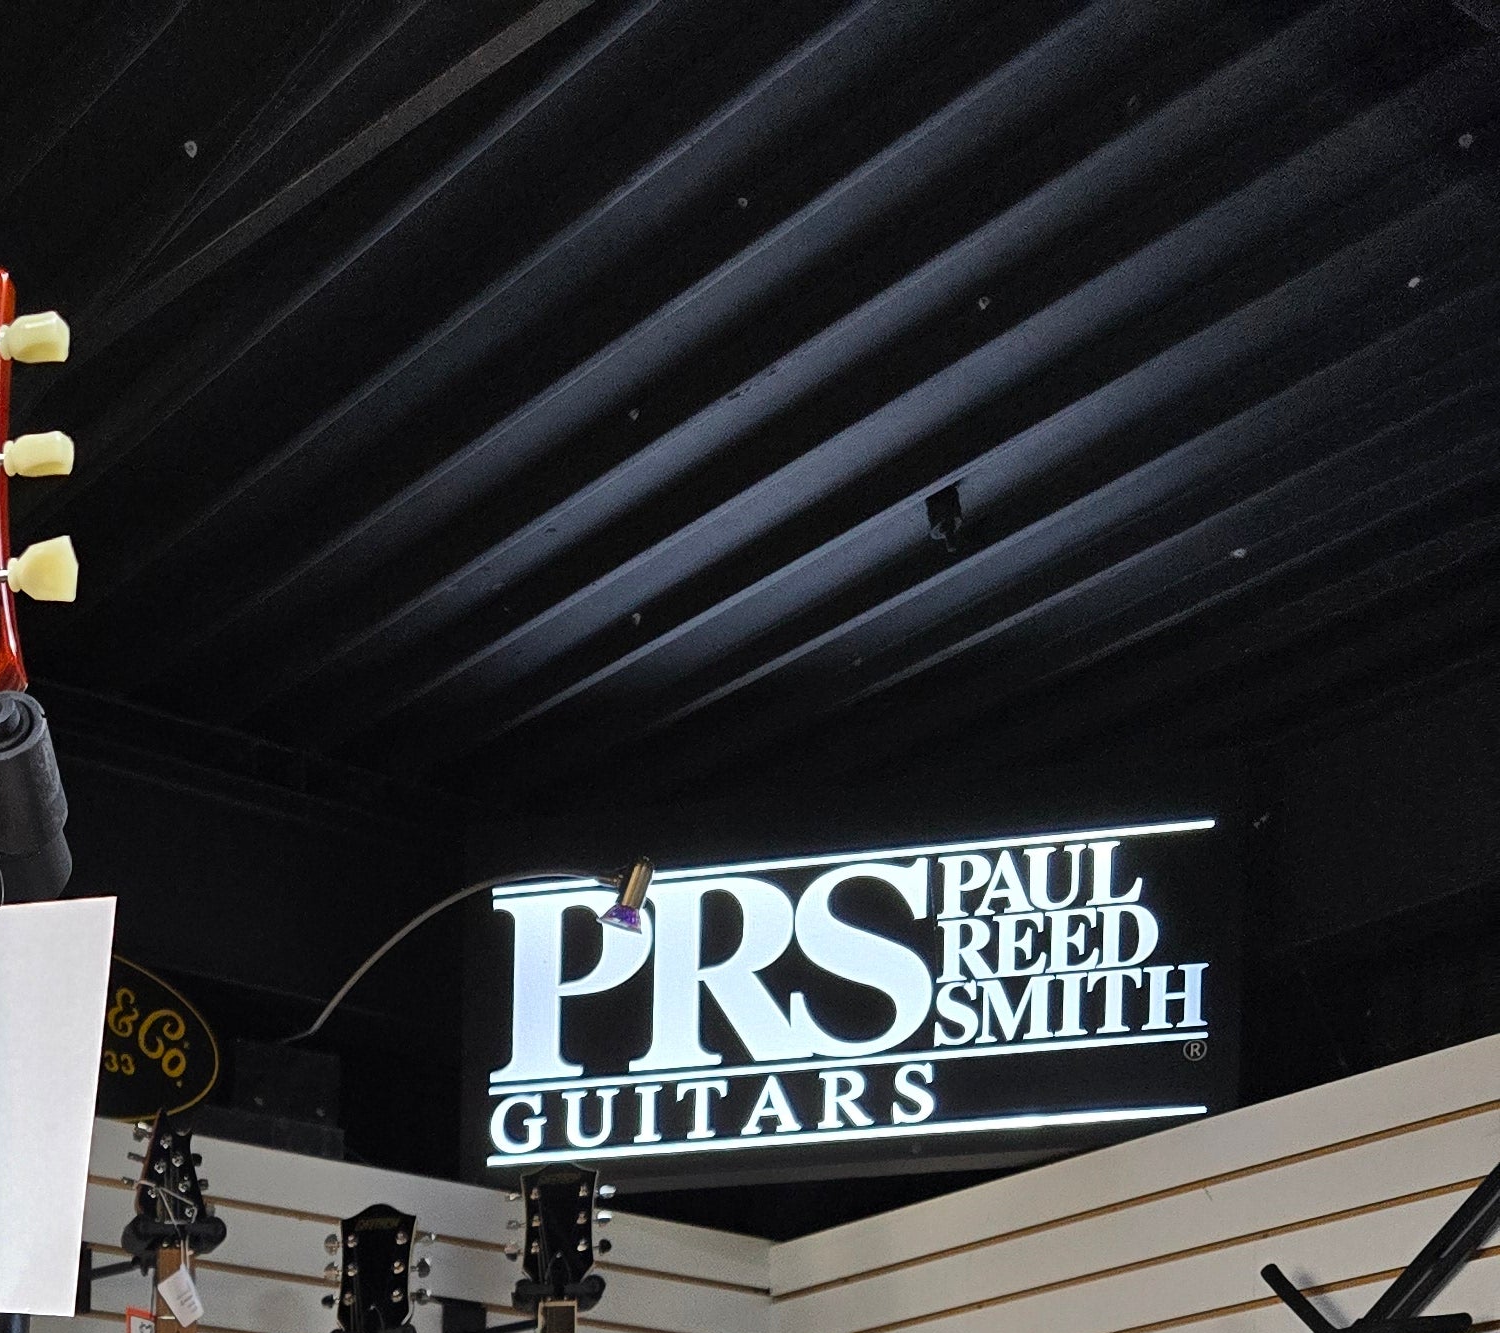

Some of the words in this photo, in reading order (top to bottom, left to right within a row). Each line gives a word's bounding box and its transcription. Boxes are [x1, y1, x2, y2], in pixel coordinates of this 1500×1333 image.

[937, 840, 1143, 920] PAUL
[490, 857, 933, 1084] PRS
[936, 904, 1160, 984] REED
[934, 962, 1210, 1047] SMITH
[489, 1062, 936, 1154] GUITARS
